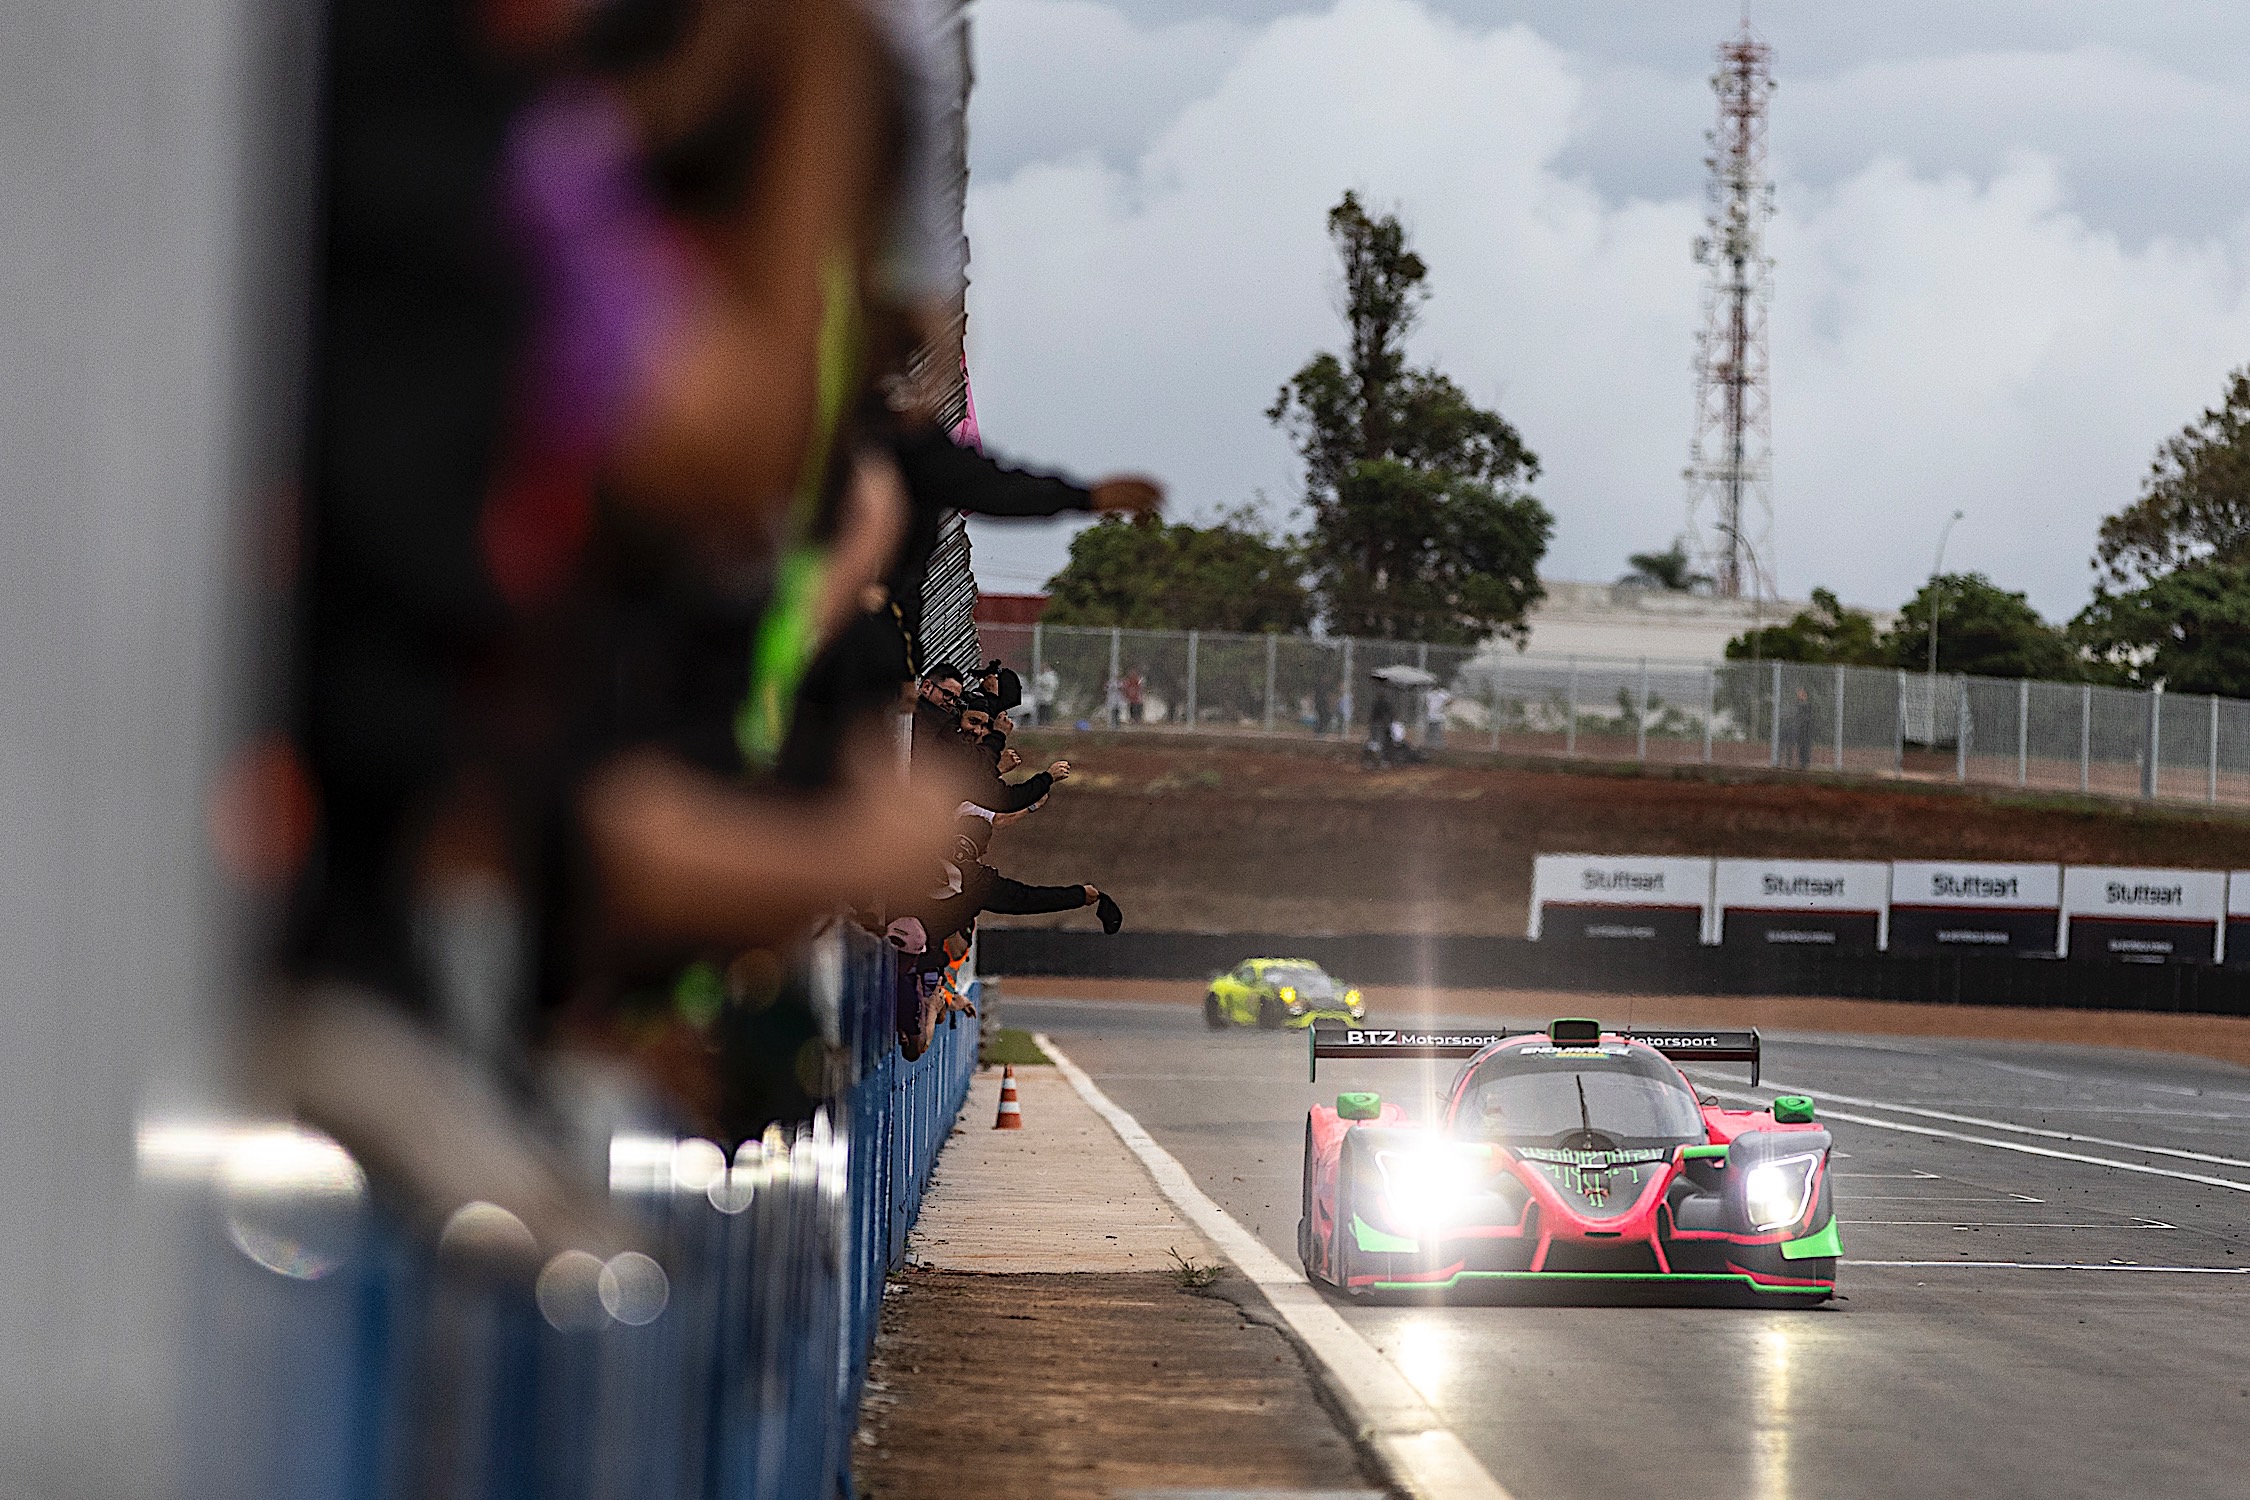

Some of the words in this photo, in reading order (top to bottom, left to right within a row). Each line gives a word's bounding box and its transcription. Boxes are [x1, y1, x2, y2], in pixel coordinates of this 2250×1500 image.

[1763, 874, 1845, 896] Stuttgart
[1932, 873, 2018, 898] Stuttgart
[2106, 882, 2182, 905] Stuttgart
[1347, 1030, 1398, 1045] BTZ
[1401, 1034, 1498, 1047] Motorsport
